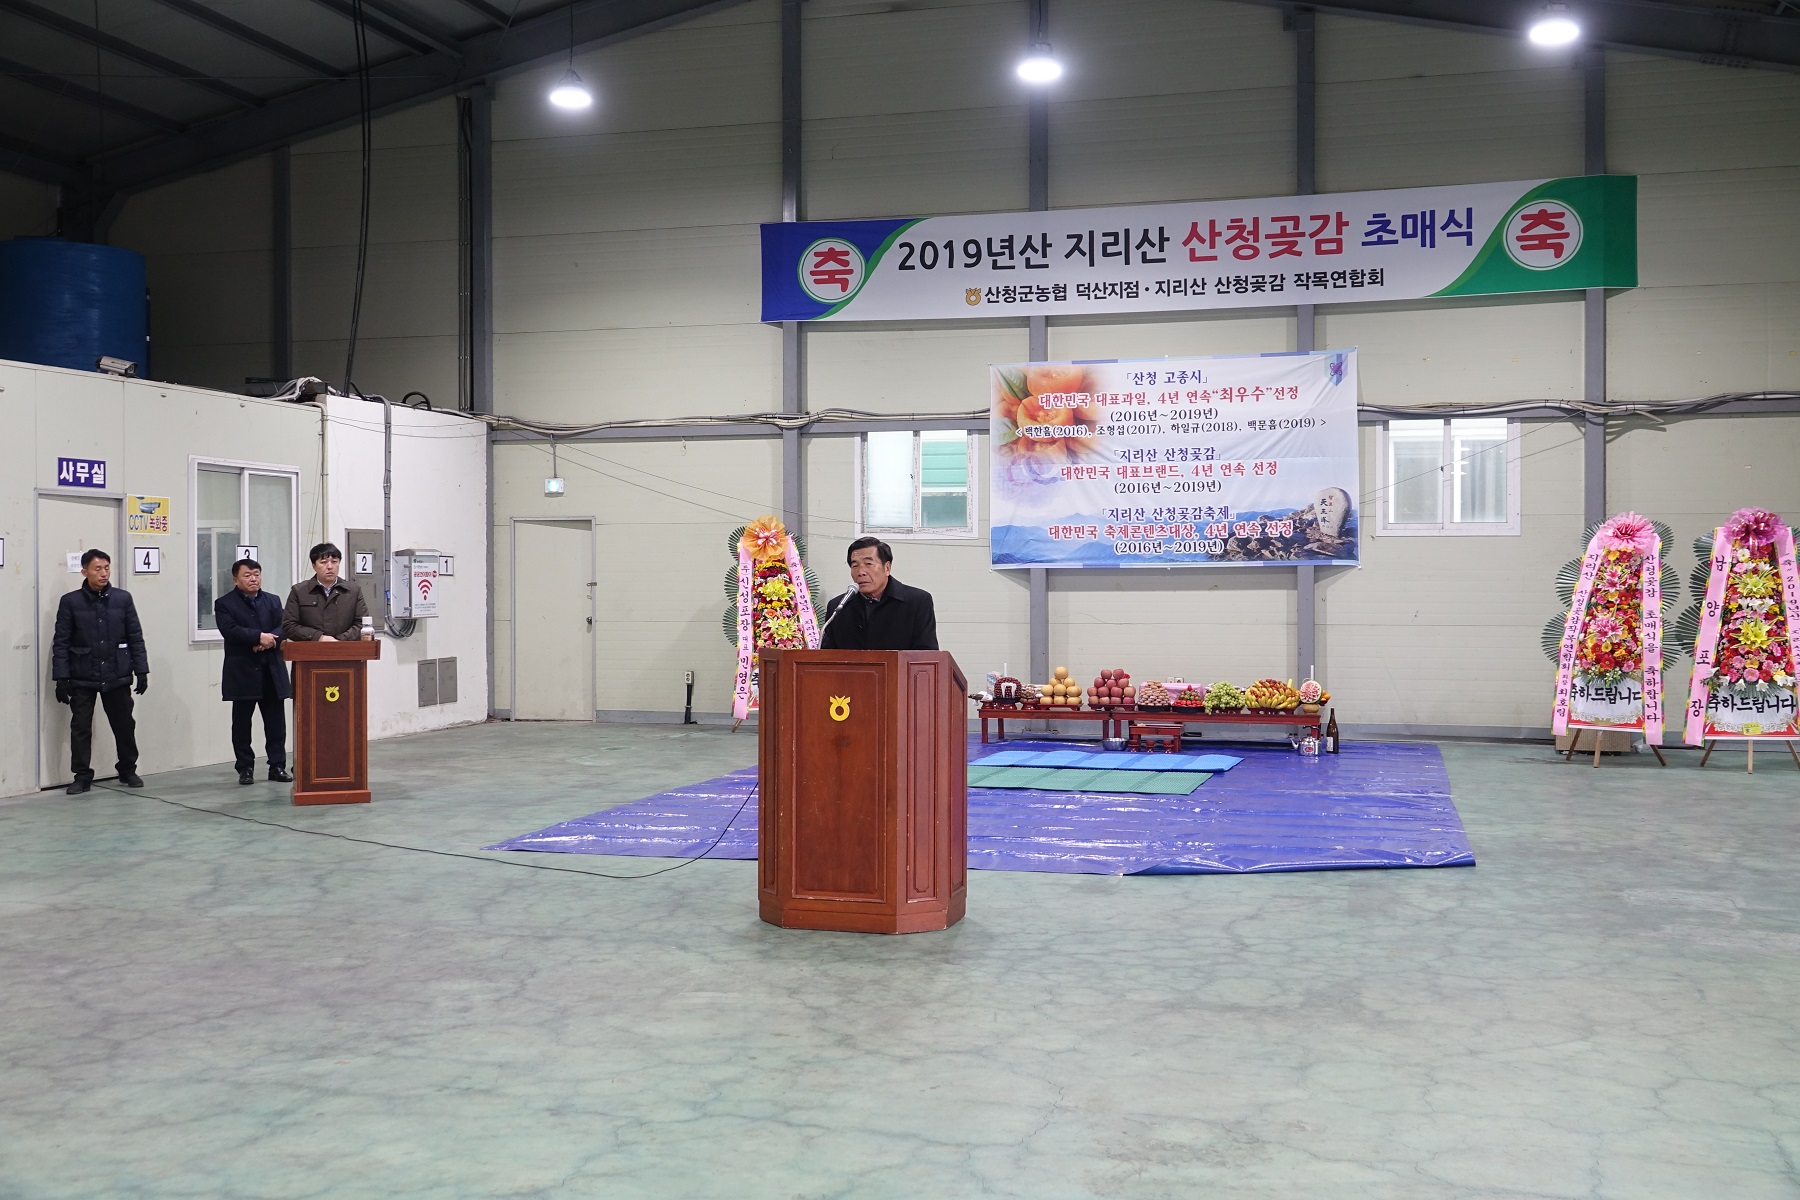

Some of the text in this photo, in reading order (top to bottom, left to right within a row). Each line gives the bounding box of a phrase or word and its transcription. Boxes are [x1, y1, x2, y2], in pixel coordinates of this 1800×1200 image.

[898, 206, 1475, 271] 2019년산 지리산 산청곶감 초매식
[1516, 208, 1571, 259] 축
[809, 246, 855, 292] 축
[984, 281, 1067, 305] 산청군농협
[1214, 272, 1286, 295] 산청곶감
[1294, 267, 1385, 290] 작목연합회
[1039, 393, 1090, 408] 대한민국
[1157, 391, 1179, 404] 4년
[59, 461, 105, 485] 사무실
[1061, 466, 1110, 480] 대한민국
[1191, 463, 1213, 477] 4년
[1220, 462, 1246, 477] 연속
[1252, 461, 1278, 476] 선정
[1049, 525, 1099, 539] 대한민국
[1205, 523, 1228, 537] 4년
[1234, 522, 1261, 537] 연속
[1266, 521, 1293, 536] 선정
[143, 551, 151, 569] 4
[361, 555, 367, 572] 2
[444, 559, 449, 573] 1
[1644, 665, 1660, 723] 축하합니다
[1708, 693, 1797, 714] 축하드립니다
